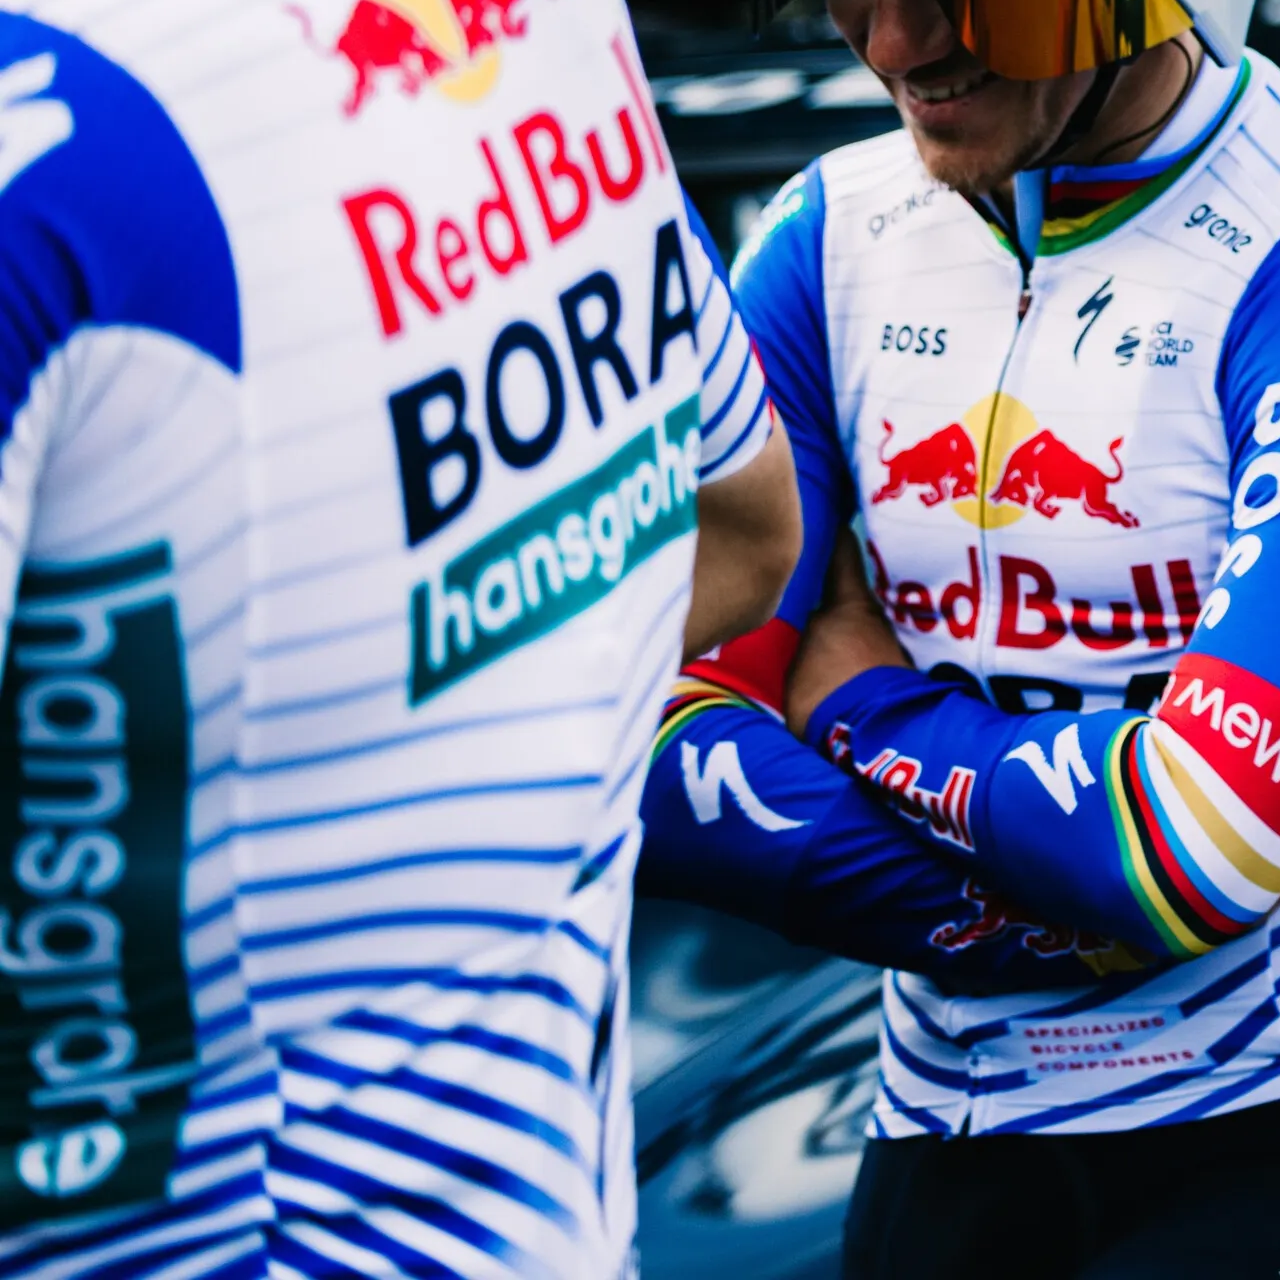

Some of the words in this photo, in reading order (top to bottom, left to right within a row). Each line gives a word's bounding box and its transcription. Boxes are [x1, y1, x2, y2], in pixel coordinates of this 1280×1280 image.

[342, 135, 529, 340] Red
[513, 28, 667, 248] Bul
[388, 218, 699, 550] BORA
[880, 323, 948, 356] BOSS
[996, 553, 1202, 651] Bull
[1037, 1049, 1194, 1071] COMPONENTS
